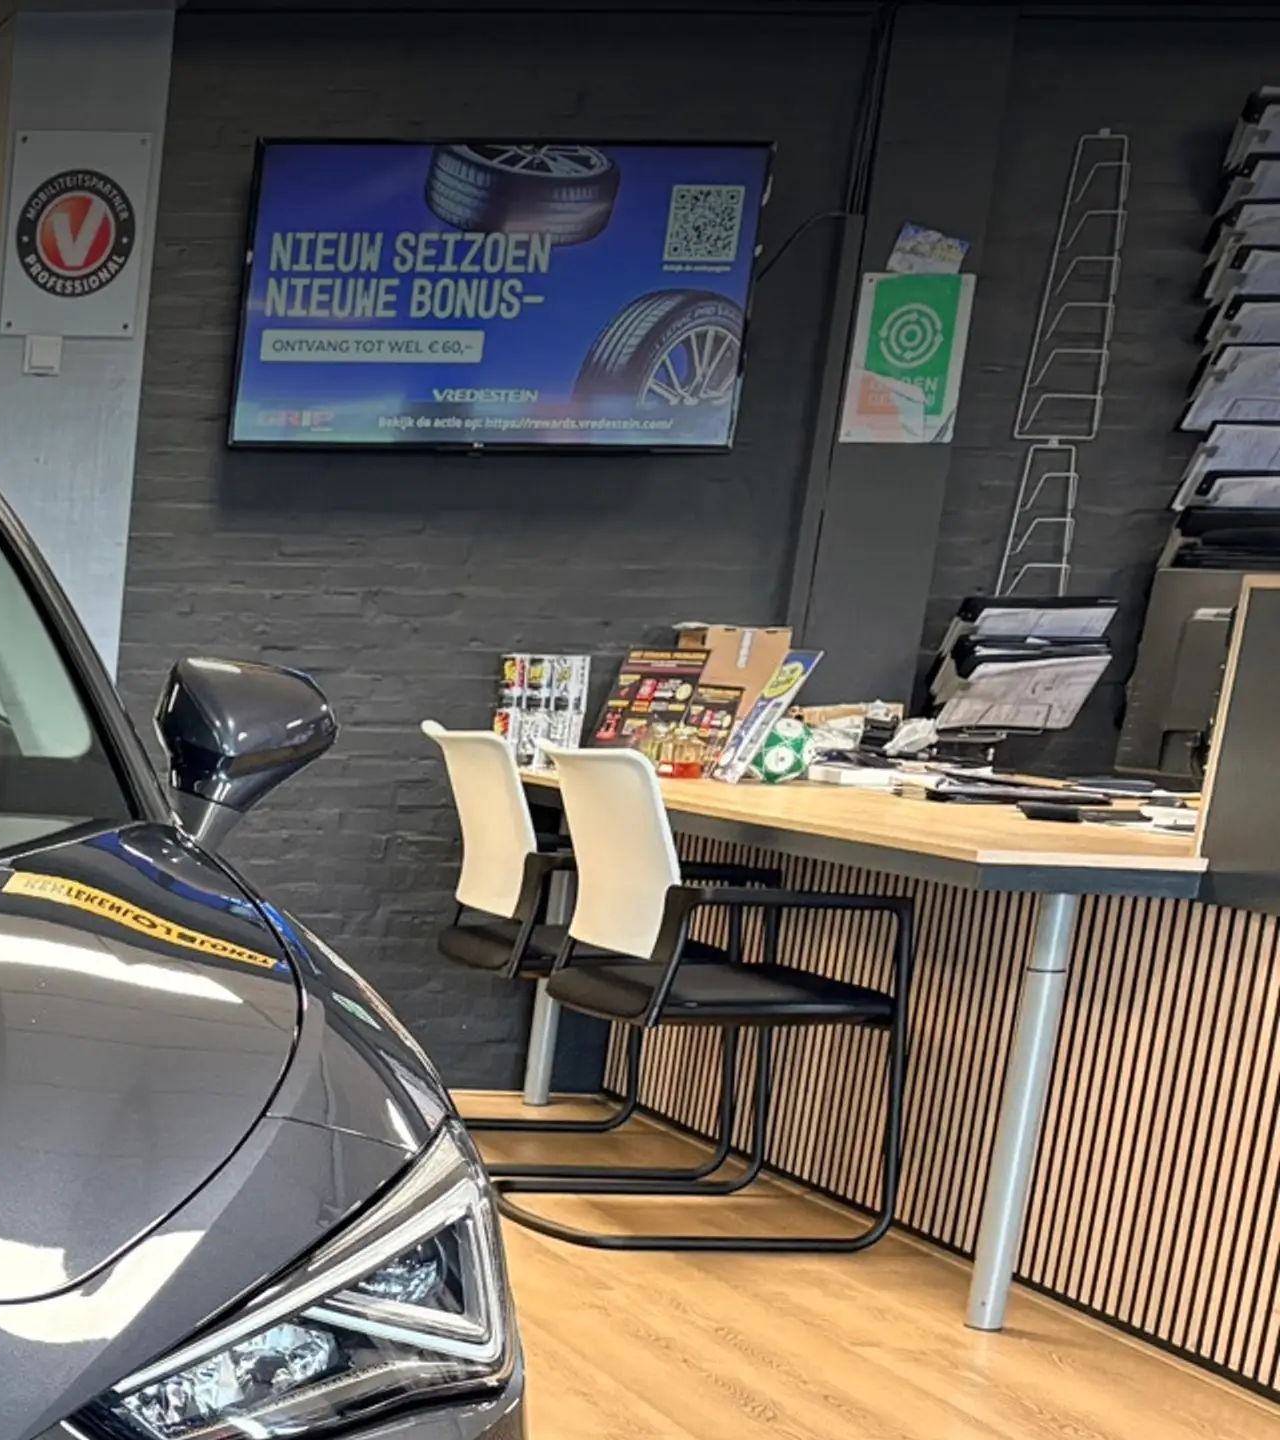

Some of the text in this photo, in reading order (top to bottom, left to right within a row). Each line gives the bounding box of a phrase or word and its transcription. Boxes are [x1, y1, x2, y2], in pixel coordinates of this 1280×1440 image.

[25, 174, 130, 222] MOBILITEITSPARTNER
[269, 231, 551, 273] NIEUW SEIZOEN
[24, 253, 126, 294] PROFESSIONAL
[265, 278, 400, 319] NIEUWE
[272, 339, 350, 354] ONTVANG
[355, 339, 385, 354] TOT
[388, 339, 423, 354] WEL
[431, 388, 540, 404] VREDESTEIN
[416, 416, 431, 429] de
[434, 416, 462, 429] actie
